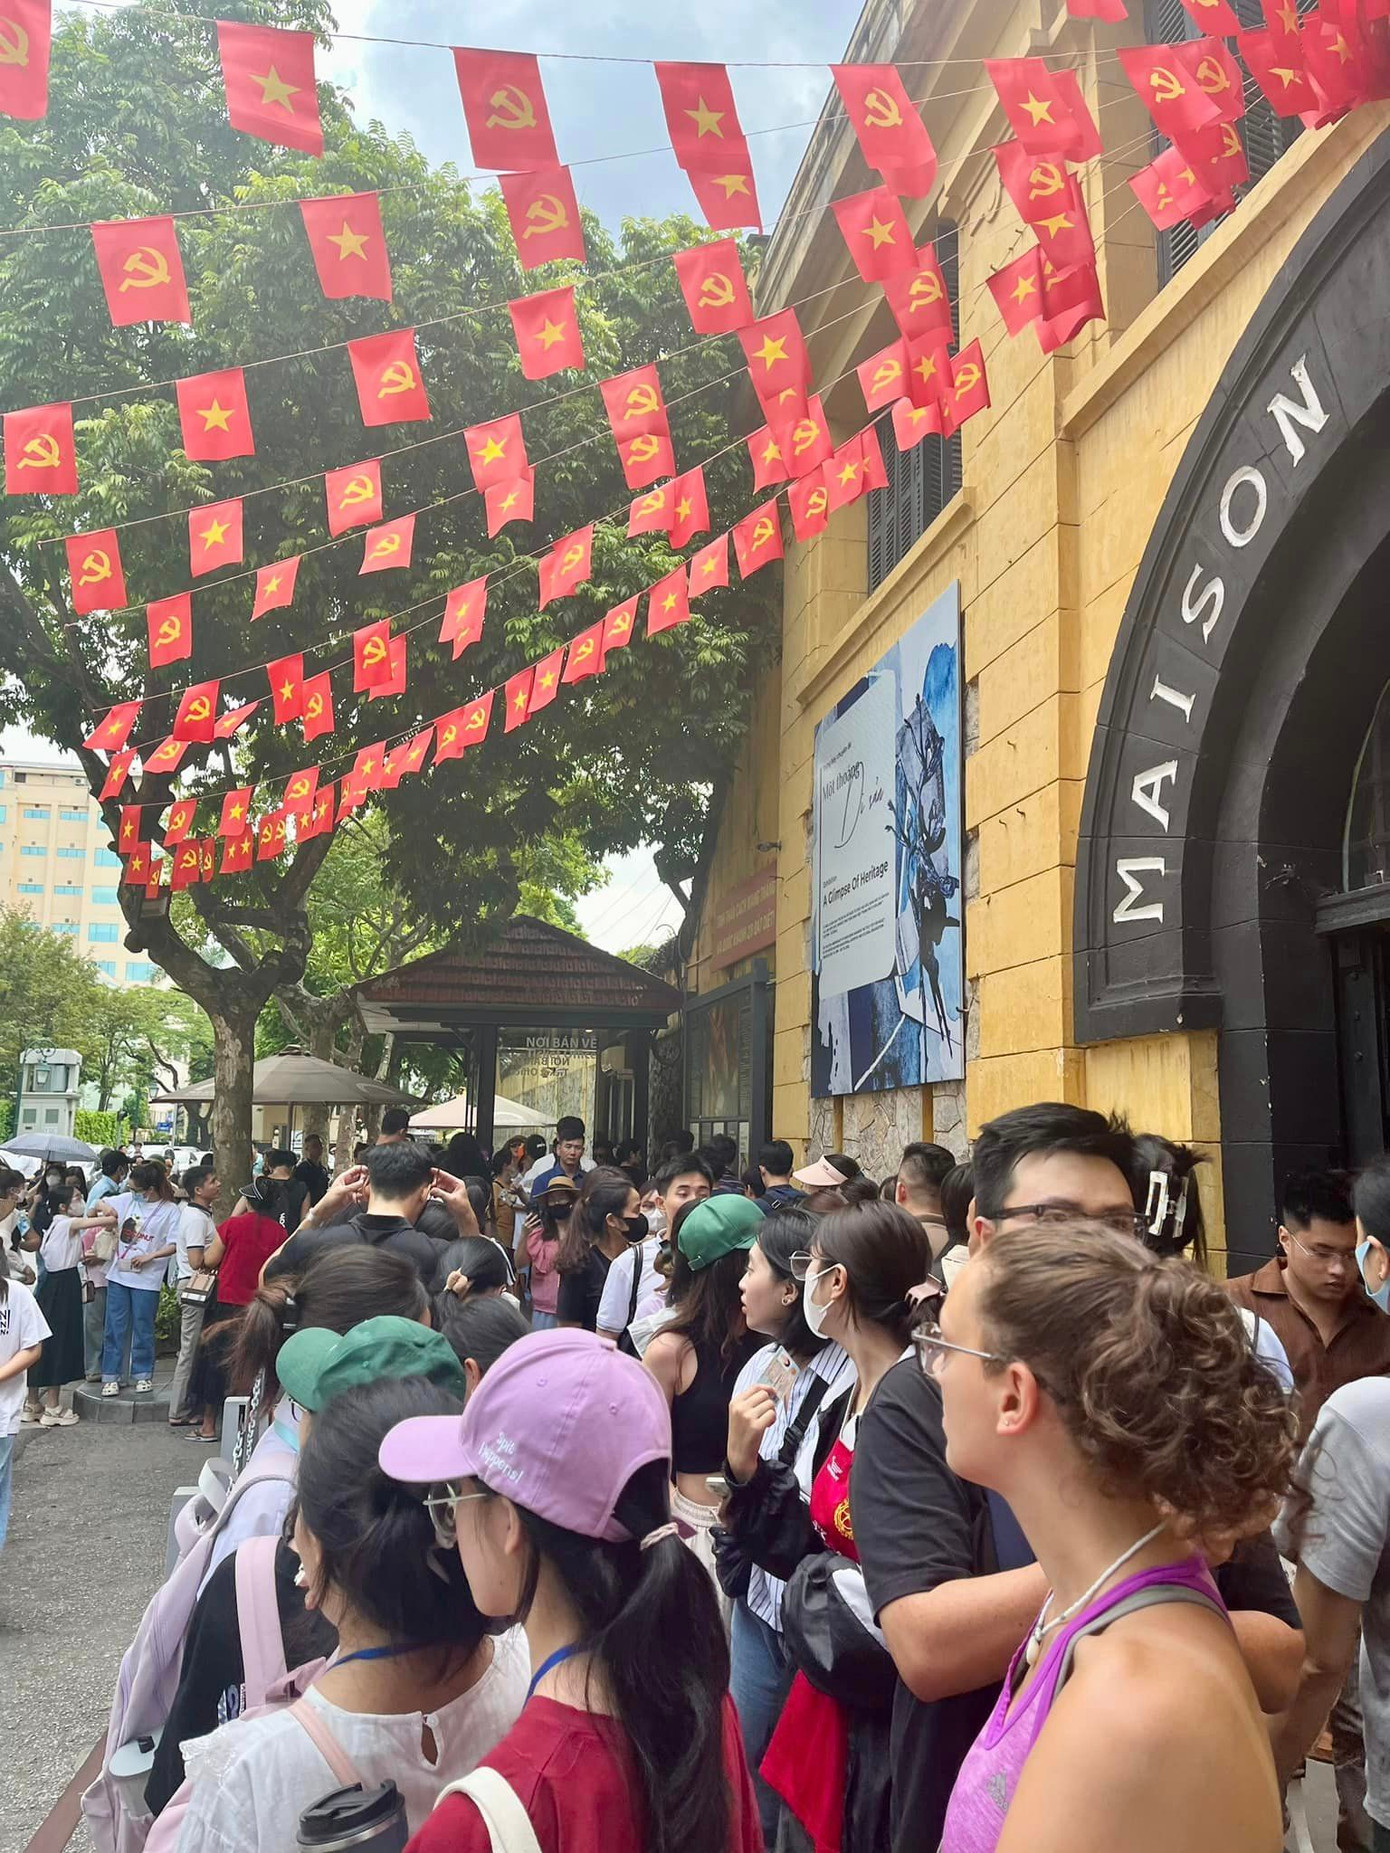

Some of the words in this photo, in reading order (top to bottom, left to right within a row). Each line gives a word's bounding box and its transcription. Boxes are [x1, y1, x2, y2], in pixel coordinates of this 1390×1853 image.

[1113, 352, 1331, 924] MAISON
[828, 884, 850, 905] Glimpse
[851, 874, 860, 890] Of
[860, 860, 889, 887] Heritage
[526, 1036, 549, 1048] NƠI
[552, 1035, 579, 1048] BÁN
